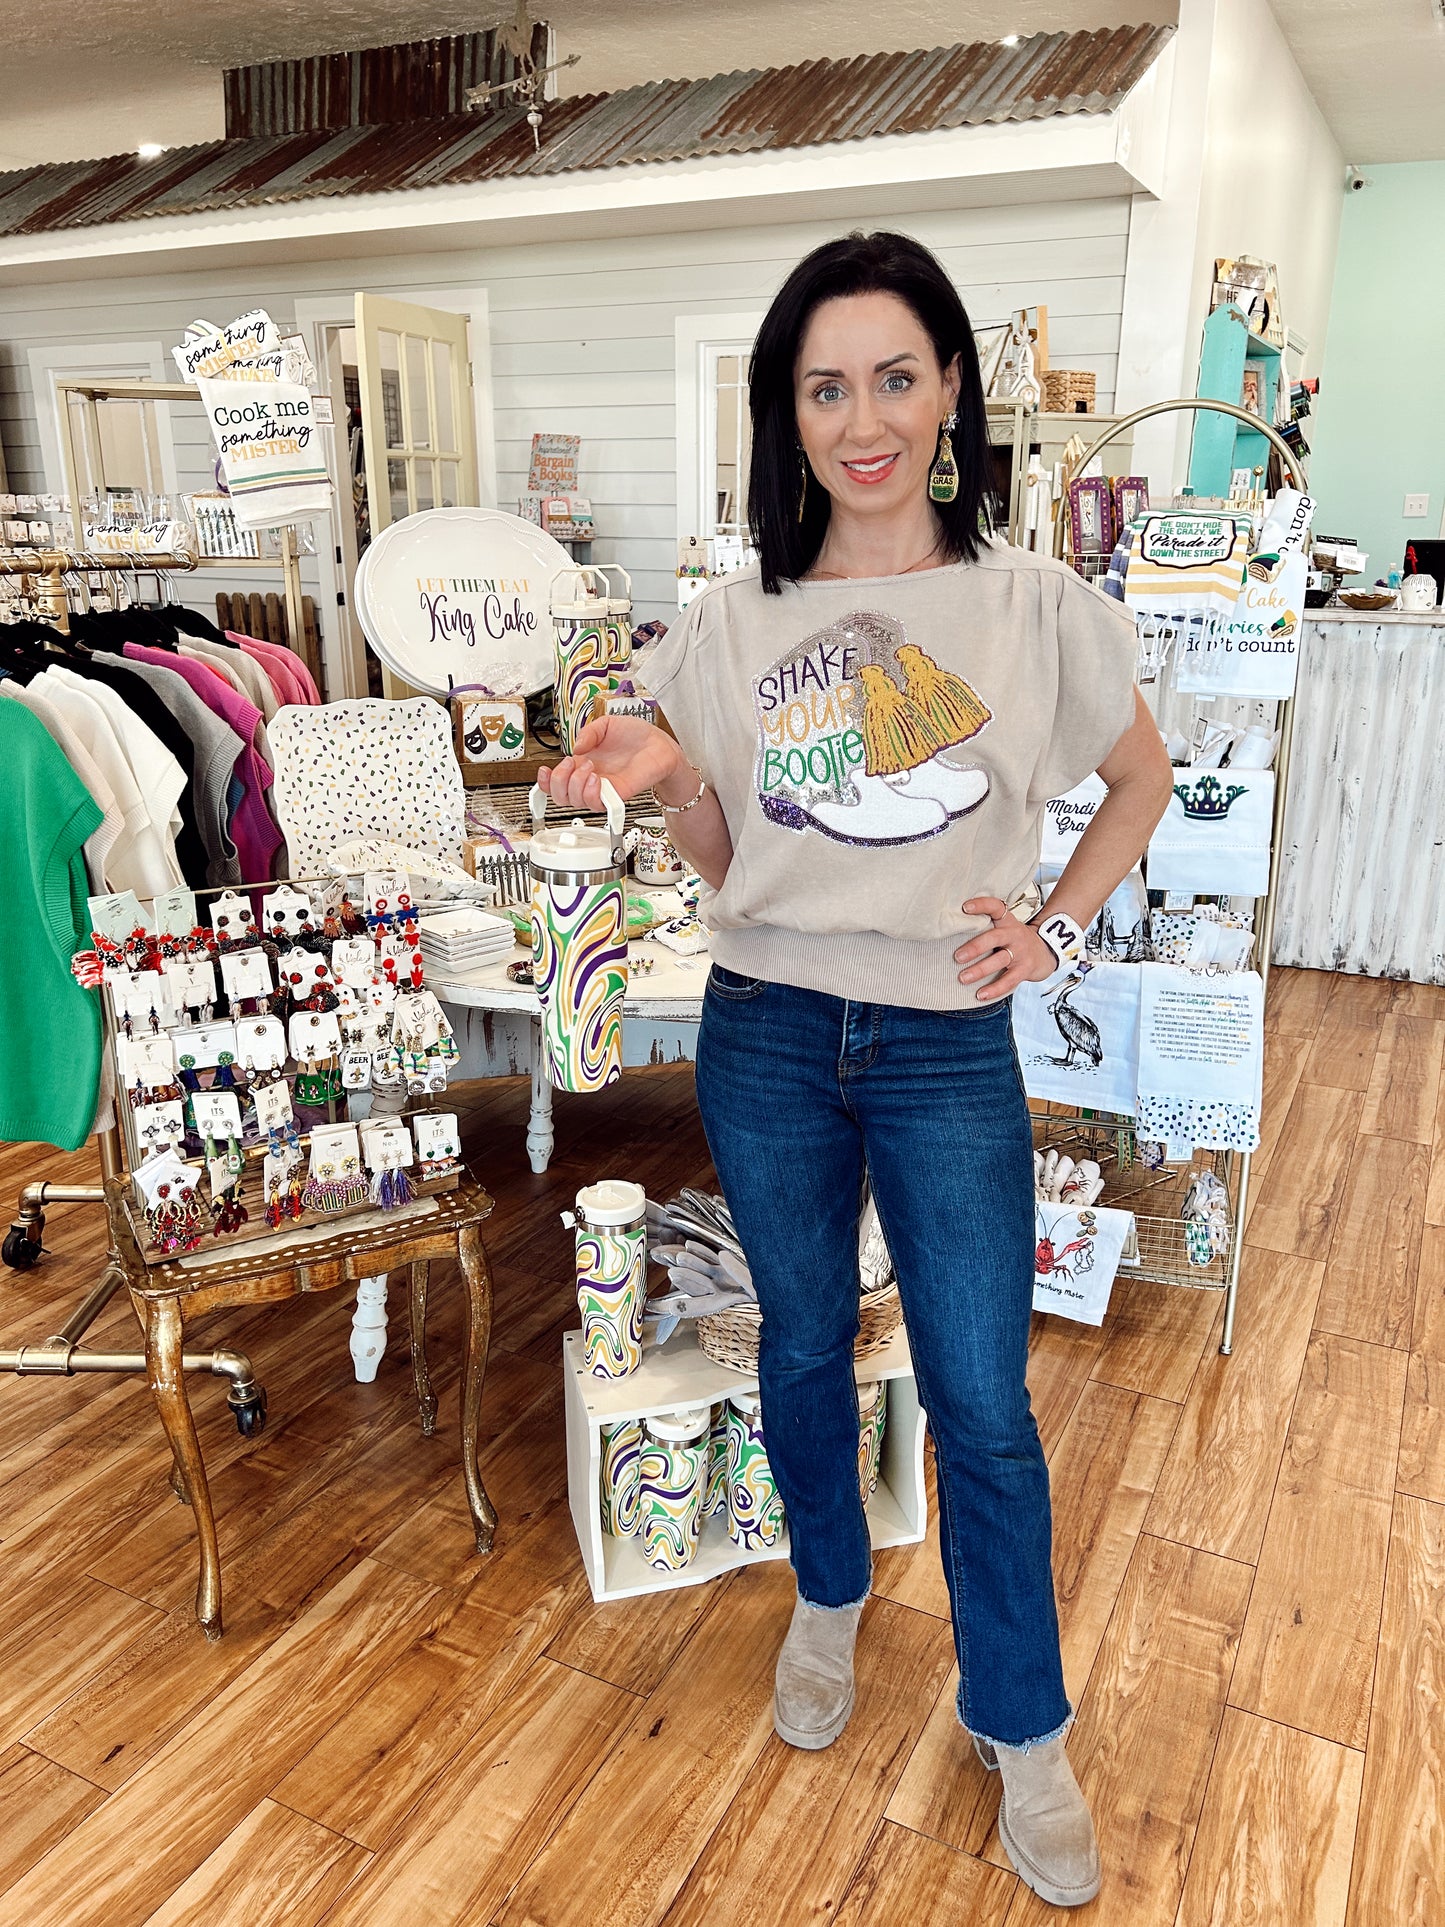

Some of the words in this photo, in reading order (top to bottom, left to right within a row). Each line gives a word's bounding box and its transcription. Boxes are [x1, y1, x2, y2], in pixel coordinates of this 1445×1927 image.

[214, 401, 271, 426] Cook
[275, 400, 310, 417] me
[221, 420, 313, 453] something
[230, 439, 300, 463] MISTER
[533, 454, 575, 470] Bargain
[539, 467, 573, 481] Books
[933, 476, 954, 485] GRAS
[1159, 526, 1175, 535] THE
[1176, 528, 1207, 536] CRAZY,
[1160, 520, 1174, 528] WE
[1175, 521, 1201, 529] DON'T
[1203, 521, 1224, 529] HIDE
[1149, 532, 1207, 551] Parade
[1207, 535, 1228, 547] it
[1149, 549, 1174, 557] DOWN
[1176, 549, 1193, 557] THE
[1194, 548, 1226, 558] STREET
[416, 577, 447, 593] LET
[449, 578, 498, 593] THEM
[499, 578, 530, 593] EAT
[1246, 587, 1289, 609] Cake
[420, 592, 477, 647] King
[483, 594, 538, 640] Cake
[1238, 638, 1296, 654] count
[758, 643, 858, 711] SHAKE
[1046, 799, 1097, 816] Mardi
[1055, 816, 1086, 836] Gra
[348, 1056, 369, 1065] BEER
[376, 1051, 390, 1062] BEE
[267, 1096, 279, 1107] ITS
[211, 1107, 225, 1115] ITS
[432, 1128, 444, 1137] ITS
[1033, 1281, 1062, 1296] mething
